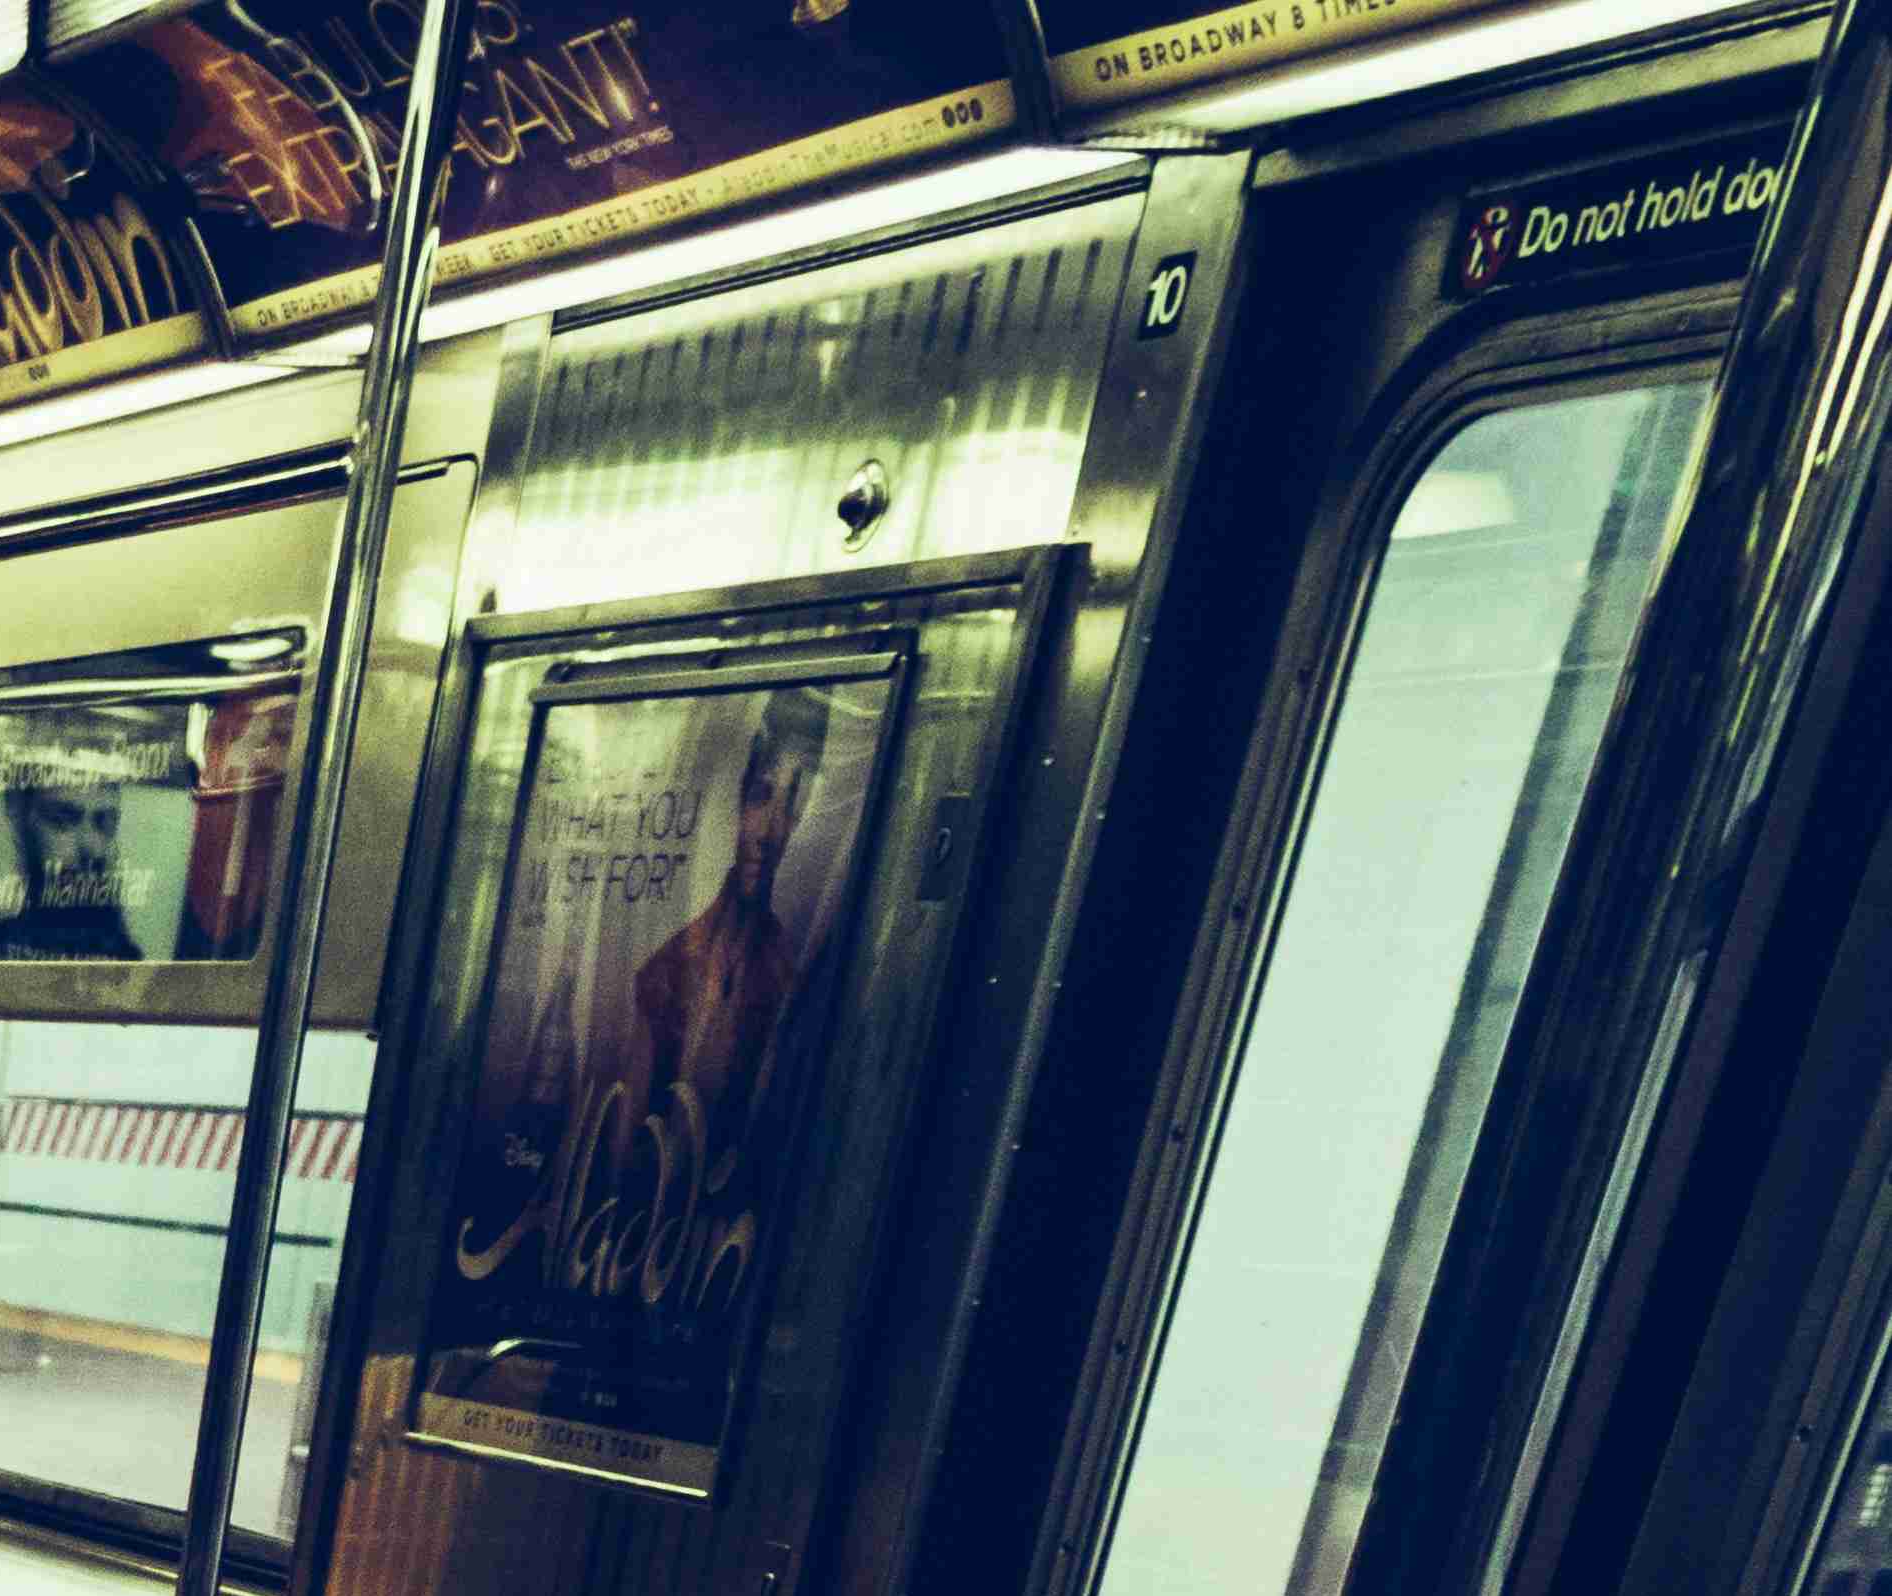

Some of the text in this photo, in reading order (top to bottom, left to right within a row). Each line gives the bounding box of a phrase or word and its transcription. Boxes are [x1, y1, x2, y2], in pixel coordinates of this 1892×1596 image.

[1096, 52, 1129, 82] ON
[1137, 11, 1277, 71] BROADWAY
[641, 187, 699, 219] TODAY
[1518, 207, 1568, 258] Do
[1572, 189, 1635, 246] not
[1636, 165, 1724, 233] hold
[1147, 265, 1186, 325] 10
[636, 790, 702, 840] YOU
[456, 1080, 756, 1312] Aladdin
[463, 1408, 665, 1461] GET YOUR TICKETS TODAY
